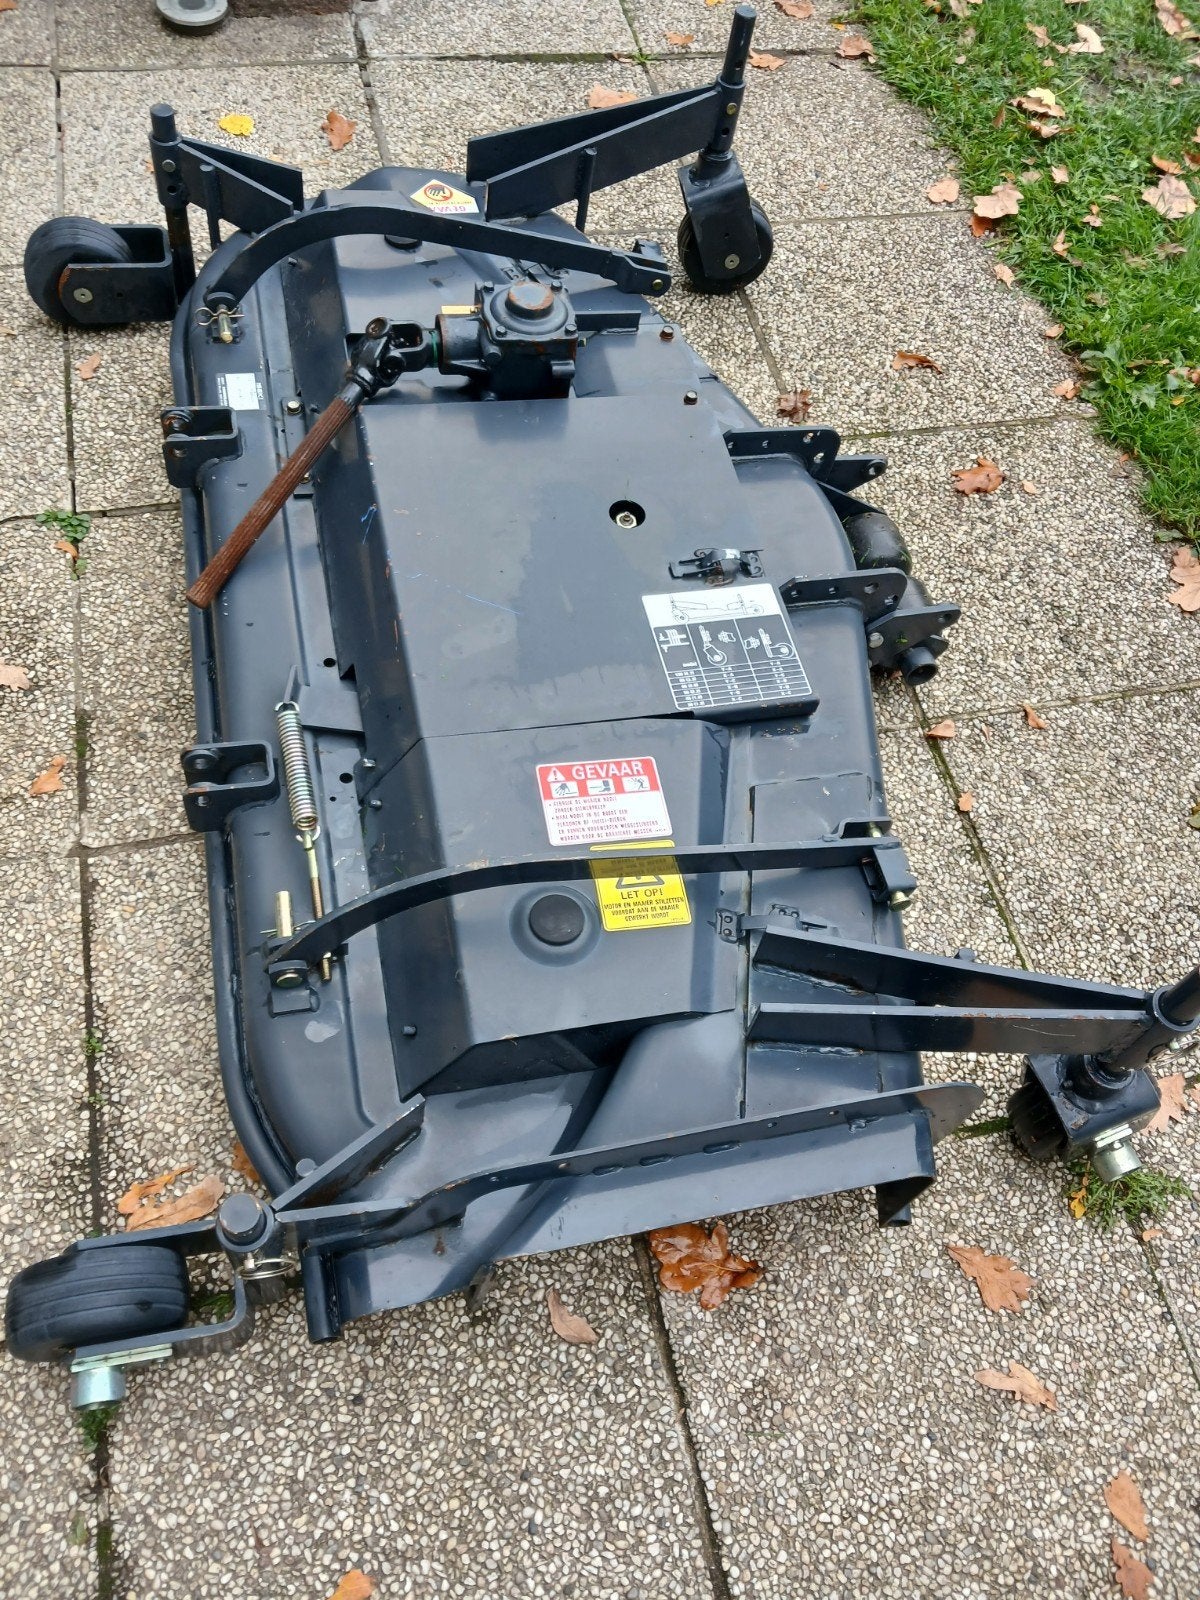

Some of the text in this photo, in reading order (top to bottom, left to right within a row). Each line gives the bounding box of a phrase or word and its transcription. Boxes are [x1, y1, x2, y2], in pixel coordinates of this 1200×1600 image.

[572, 761, 644, 780] GEVAAR
[620, 888, 663, 900] LET OP!
[604, 902, 622, 910] MOTOR
[633, 899, 654, 907] MAAIER
[655, 896, 685, 905] STILZETTEN
[612, 907, 635, 916] VOORDAT
[659, 903, 679, 911] MAAIER
[625, 914, 649, 922] GEWERKT
[651, 912, 669, 920] WORDT
